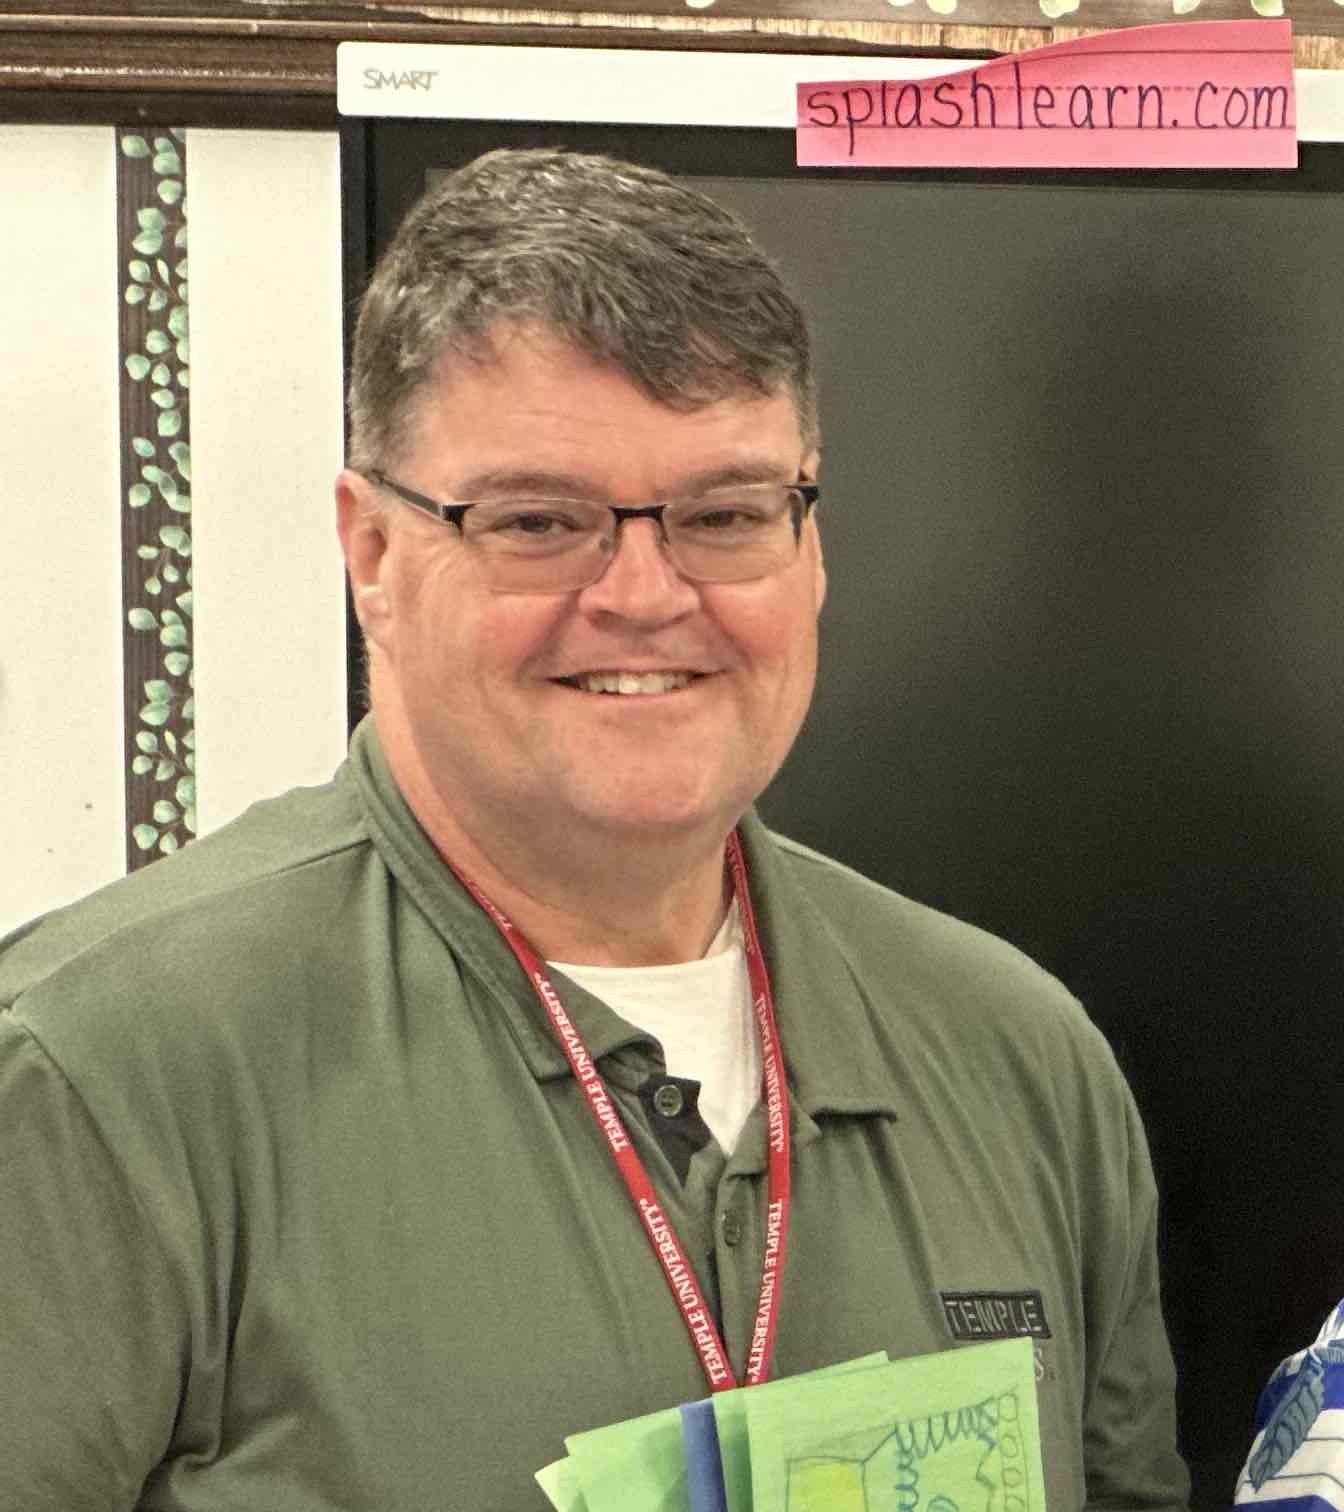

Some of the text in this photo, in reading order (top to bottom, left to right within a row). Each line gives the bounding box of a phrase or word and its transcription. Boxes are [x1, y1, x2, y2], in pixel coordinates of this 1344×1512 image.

[362, 68, 439, 91] SMART
[806, 61, 1289, 156] splashlearn.com
[588, 1074, 628, 1153] TEMPLE
[764, 1199, 783, 1268] TEMPLE
[685, 1302, 727, 1384] TEMPLE
[944, 1300, 1042, 1333] TEMPLE
